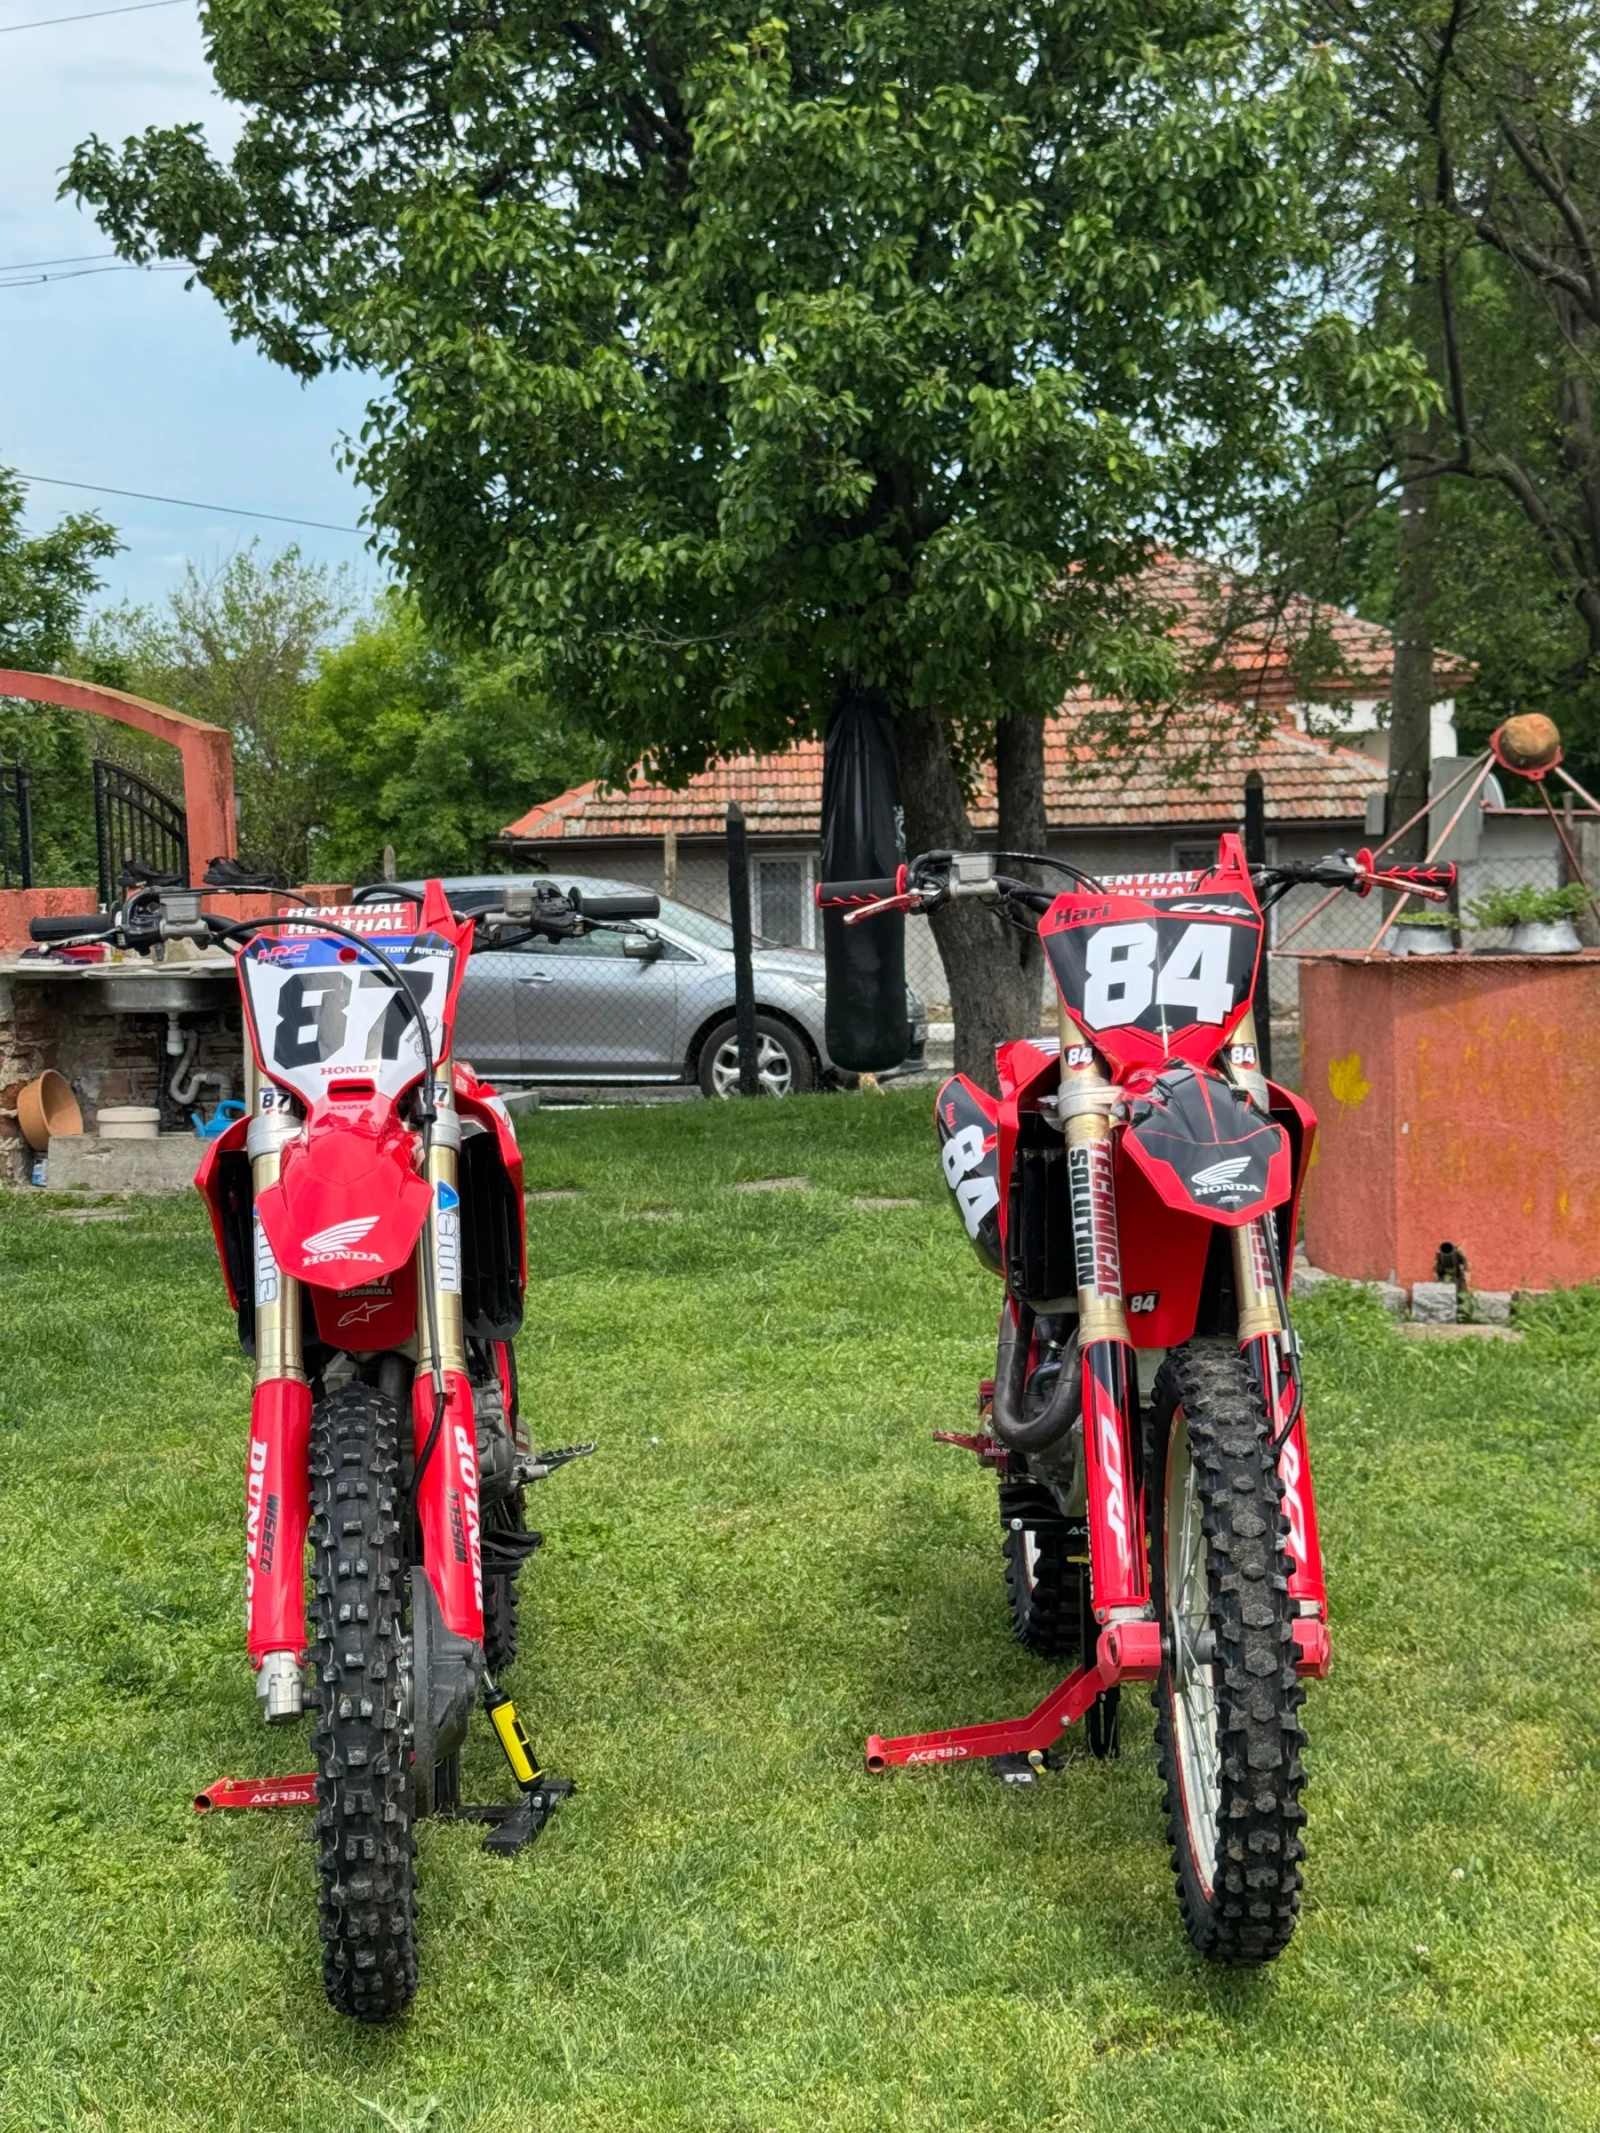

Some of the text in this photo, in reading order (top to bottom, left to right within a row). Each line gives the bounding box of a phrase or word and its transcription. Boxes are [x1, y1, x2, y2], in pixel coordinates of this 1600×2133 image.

[286, 902, 408, 918] RENTHAL
[1054, 902, 1111, 927] Hari
[1169, 902, 1254, 917] CRF
[287, 917, 409, 935] RETHAL
[256, 943, 310, 966] HRC
[360, 946, 454, 957] FTORY RACING
[1084, 922, 1234, 1031] 84
[273, 971, 434, 1070] 87
[1068, 1046, 1093, 1067] 84
[1230, 1045, 1256, 1065] 84
[262, 1093, 290, 1109] 87
[942, 1124, 1000, 1241] 84
[1194, 1183, 1262, 1196] HONDA
[1070, 1149, 1095, 1288] SOLUTION
[1089, 1139, 1121, 1297] TECHNICAL
[302, 1251, 385, 1267] HONDA
[337, 1287, 393, 1298] YOSHIMURA
[1131, 1295, 1156, 1313] 84
[1101, 1413, 1130, 1568] CRF
[259, 1493, 281, 1575] WISECO
[445, 1486, 470, 1565] WISECO
[906, 1746, 968, 1762] ACERBIS
[250, 1790, 310, 1804] ACERBIS
